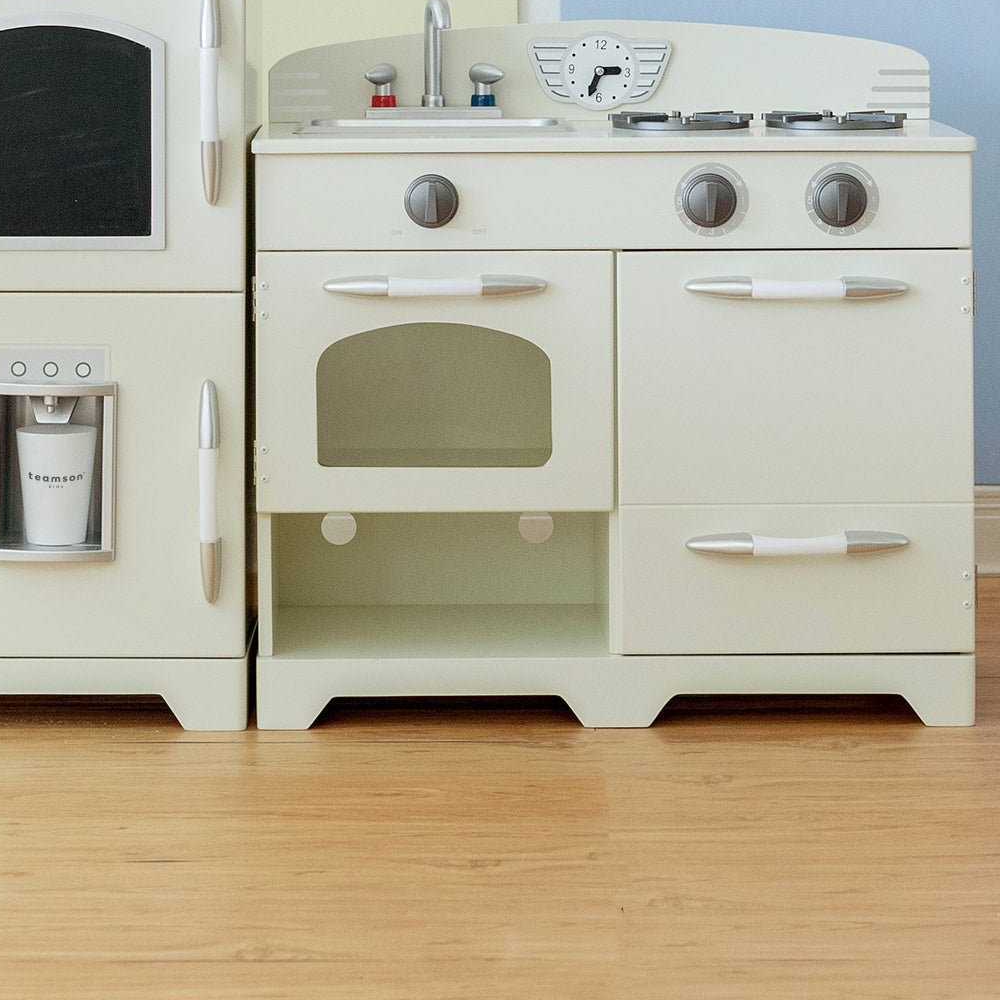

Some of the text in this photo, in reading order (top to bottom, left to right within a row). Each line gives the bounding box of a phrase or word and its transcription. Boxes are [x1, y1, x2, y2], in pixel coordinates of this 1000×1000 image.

[594, 39, 608, 50] 12
[568, 63, 575, 75] 9
[624, 67, 631, 78] 3
[595, 92, 603, 103] 6
[472, 228, 487, 236] OFF
[28, 471, 83, 483] teamson
